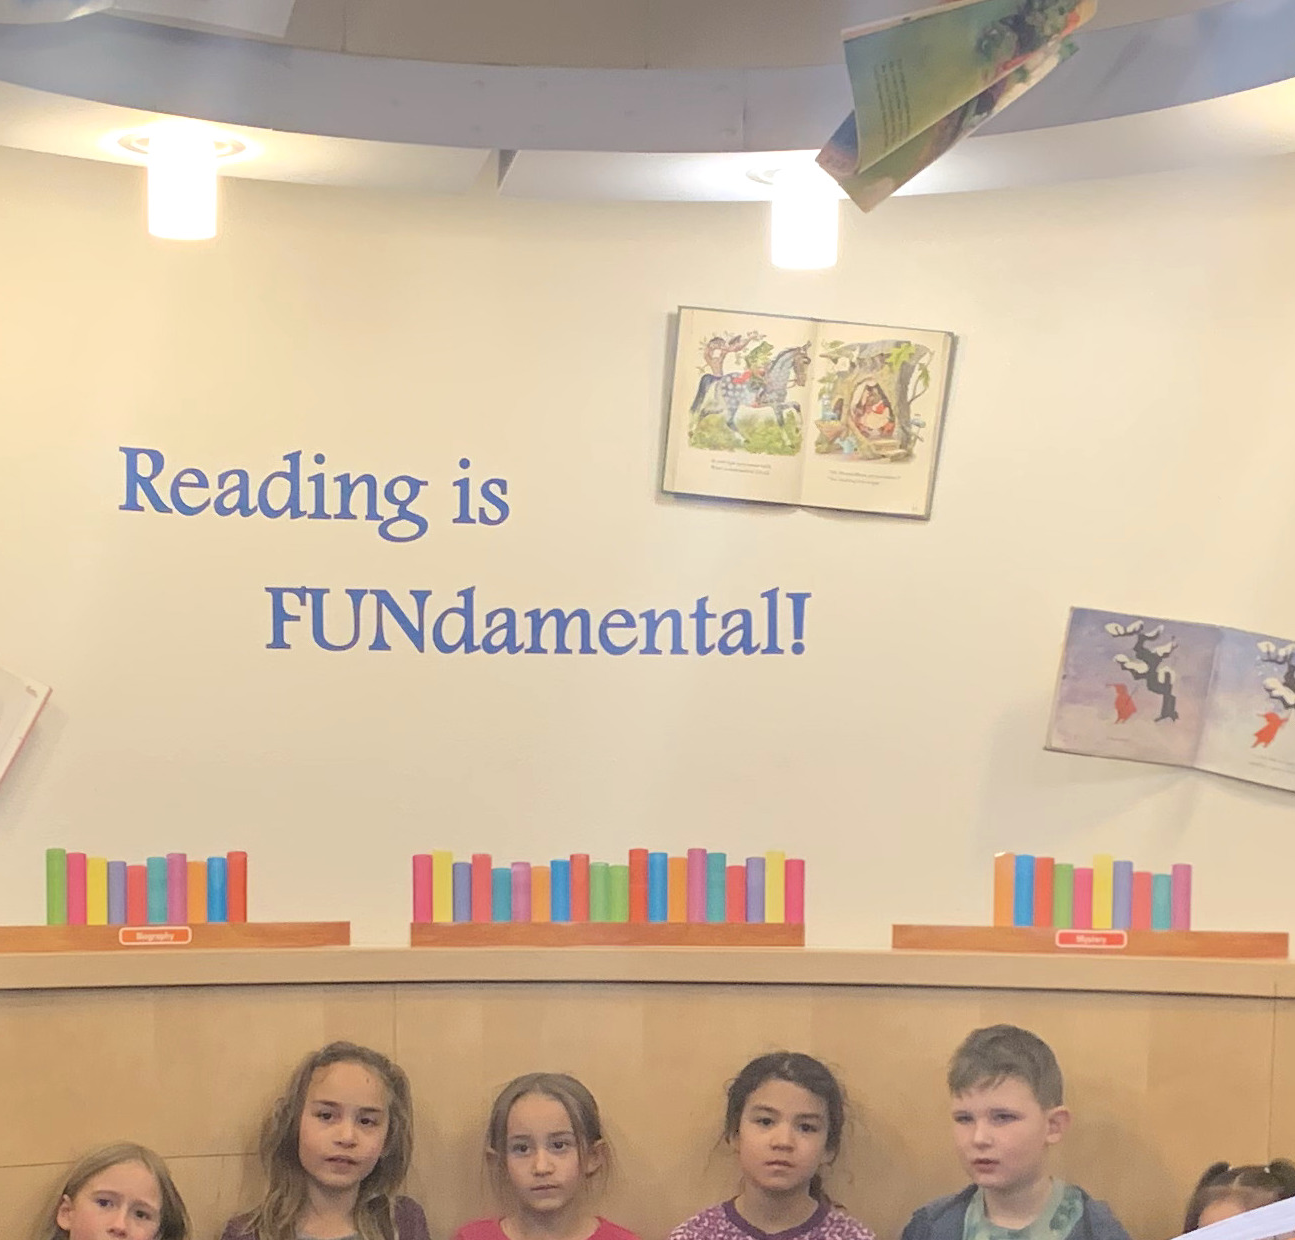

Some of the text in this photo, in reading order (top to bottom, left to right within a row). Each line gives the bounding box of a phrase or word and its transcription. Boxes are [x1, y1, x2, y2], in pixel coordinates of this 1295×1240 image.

[118, 446, 510, 542] Reading is
[264, 586, 812, 655] FUNdamental!
